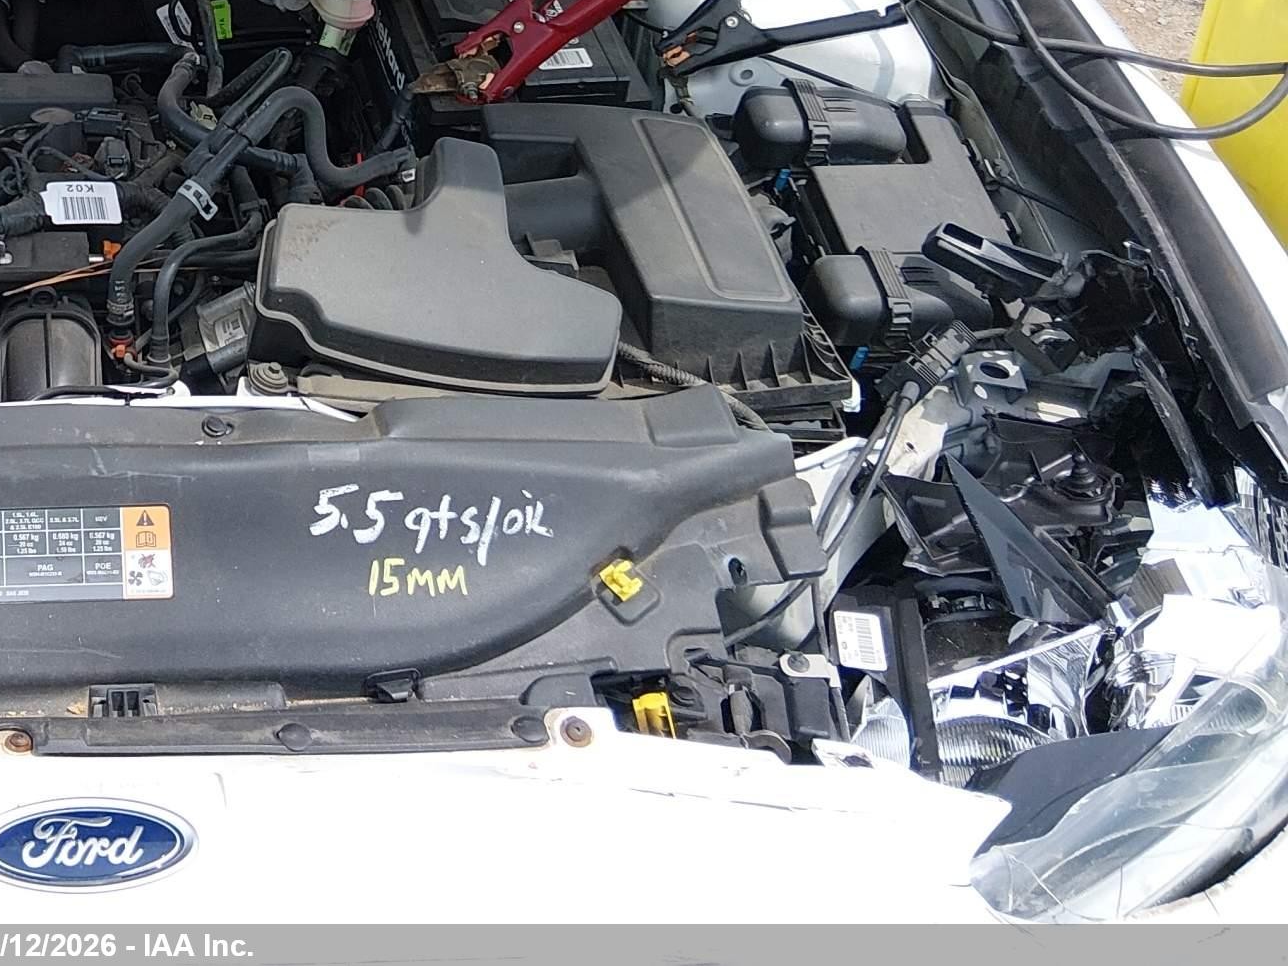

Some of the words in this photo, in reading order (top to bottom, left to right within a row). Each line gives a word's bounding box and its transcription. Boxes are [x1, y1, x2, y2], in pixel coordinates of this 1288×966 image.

[65, 184, 95, 193] K02
[309, 483, 403, 544] 5.5
[36, 564, 53, 572] PAG
[95, 562, 112, 570] POE
[21, 815, 145, 868] Ford
